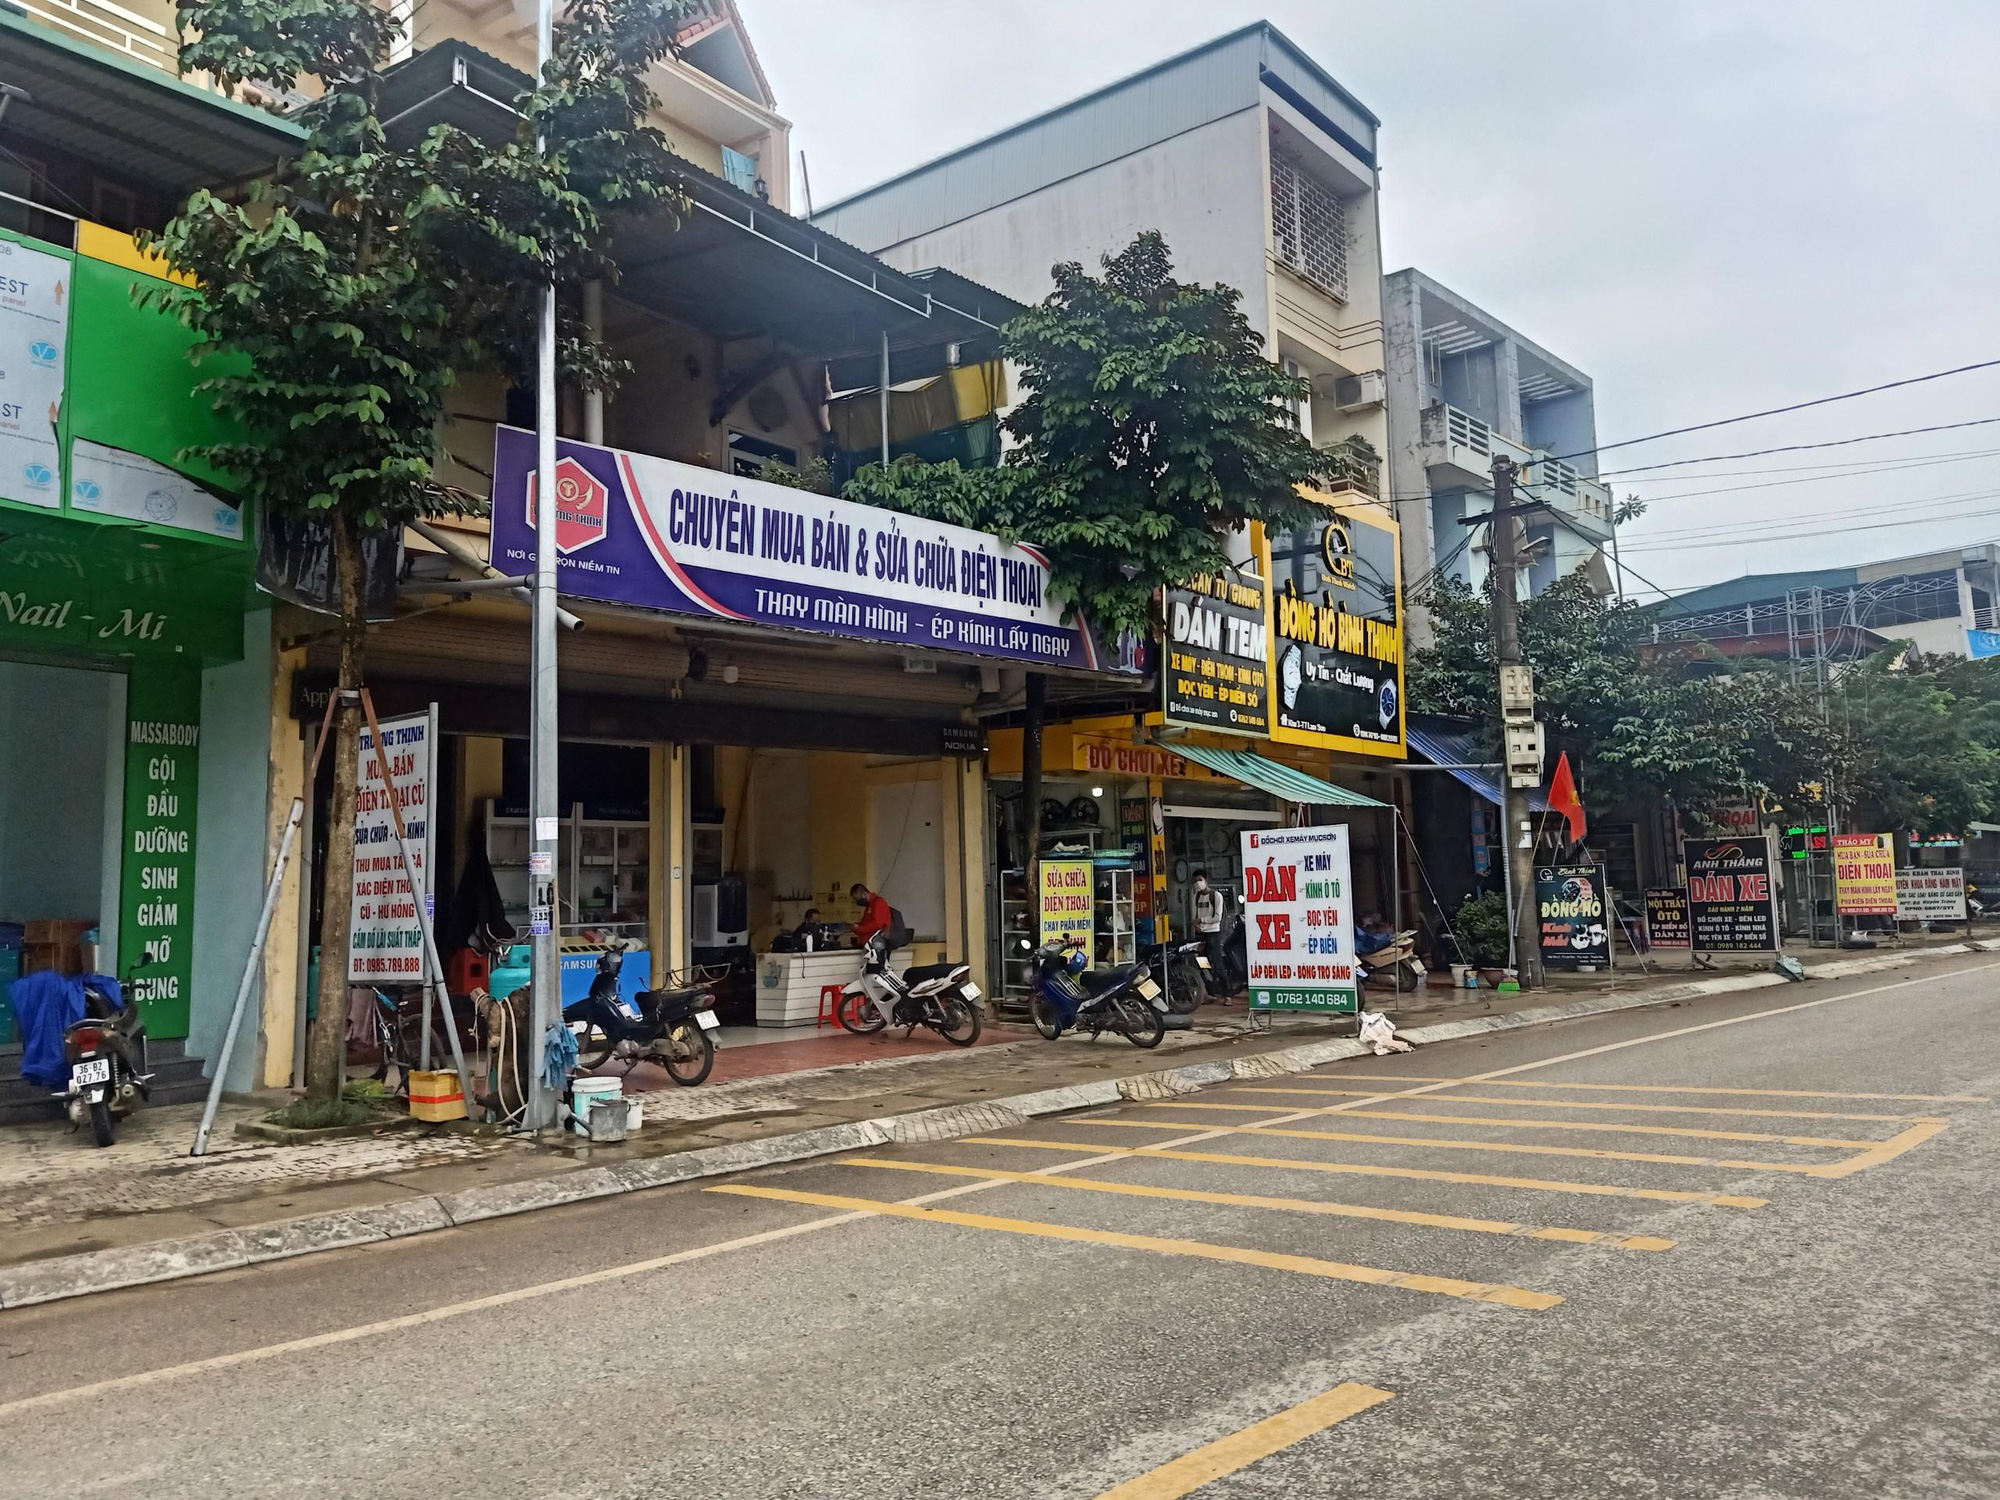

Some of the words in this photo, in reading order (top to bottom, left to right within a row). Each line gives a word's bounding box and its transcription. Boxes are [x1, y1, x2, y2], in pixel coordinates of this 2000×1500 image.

[507, 549, 526, 560] NƠI
[606, 565, 620, 575] TIN
[670, 489, 755, 556] CHUYÊN
[761, 507, 805, 565] MUA
[811, 510, 850, 573] BÁN
[856, 528, 868, 576] &
[875, 517, 908, 584] SỬA
[914, 535, 956, 592] CHỮA
[961, 544, 997, 608] ĐIỆN
[1001, 558, 1041, 617] THOẠI
[1231, 583, 1261, 610] GIANG
[755, 588, 809, 618] THAY
[814, 595, 860, 627] MÀN
[865, 604, 908, 634] HÌNH
[931, 612, 954, 639] ÉP
[959, 619, 995, 646] KÍNH
[999, 625, 1028, 651] LẤY
[1033, 633, 1070, 657] NGAY
[1173, 596, 1221, 651] DÁN
[1228, 616, 1266, 662] TEM
[1280, 578, 1316, 645] ĐỒNG
[1319, 589, 1336, 650] HỒ
[1338, 600, 1364, 656] BÌNH
[1366, 619, 1398, 671] THỊNH
[1171, 652, 1180, 670] XE
[1305, 661, 1317, 681] Uy
[1318, 660, 1330, 681] Tín
[1335, 666, 1352, 686] Chất
[1352, 672, 1374, 693] Lượng
[1178, 679, 1196, 700] BỌC
[1248, 690, 1258, 708] SỐ
[131, 721, 199, 746] MASSABODY
[396, 725, 424, 746] THỊNH
[944, 741, 976, 750] NOKIA
[149, 754, 175, 785] GỘI
[393, 748, 414, 776] BÁN
[1160, 752, 1179, 777] XE
[147, 788, 178, 817] ĐẦU
[356, 786, 378, 816] ĐIỆN
[412, 778, 424, 806] CŨ
[134, 826, 188, 853] DƯỠNG
[407, 816, 425, 840] KÍNH
[1286, 834, 1307, 844] XEMÁY
[356, 858, 370, 873] THU
[373, 856, 391, 871] MUA
[1304, 855, 1313, 872] XE
[1315, 851, 1331, 871] MÁY
[1693, 860, 1719, 869] ANH
[1723, 856, 1763, 868] THẮNG
[1838, 861, 1861, 883] ĐIỆN
[1864, 862, 1892, 882] THOẠI
[141, 867, 178, 890] SINH
[356, 879, 371, 896] XÁC
[374, 877, 394, 898] ĐIỆN
[1047, 865, 1063, 888] SỬA
[1065, 868, 1087, 888] CHỮA
[1245, 857, 1297, 902] DÁN
[1305, 879, 1322, 899] KÍNH
[1331, 878, 1340, 899] TÔ
[1690, 871, 1734, 902] DÁN
[1737, 874, 1768, 901] XE
[137, 896, 178, 927] GIẢM
[360, 902, 370, 920] CŨ
[378, 903, 390, 919] HƯ
[391, 898, 414, 919] HỎNG
[1044, 891, 1064, 915] ĐIỆN
[1066, 895, 1090, 914] THOẠI
[1541, 894, 1579, 918] ĐỒNG
[1582, 893, 1601, 917] HỒ
[1648, 898, 1663, 910] NỘI
[1307, 910, 1321, 930] BỌC
[1323, 905, 1338, 926] YÊN
[1698, 924, 1714, 932] KÍNH
[1754, 914, 1766, 922] LED
[1256, 914, 1291, 950] XE
[1308, 934, 1318, 954] ÉP
[1320, 931, 1337, 954] BIỂN
[1723, 933, 1730, 941] XE
[145, 935, 171, 964] MỠ
[353, 959, 365, 973] ĐT:
[366, 957, 420, 972] 0985.789.888
[1280, 964, 1291, 979] LED
[1298, 963, 1316, 980] BÓNG
[1332, 962, 1350, 980] SÁNG
[1276, 993, 1302, 1004] 0762
[1305, 994, 1324, 1005] 140
[1327, 994, 1347, 1005] 684
